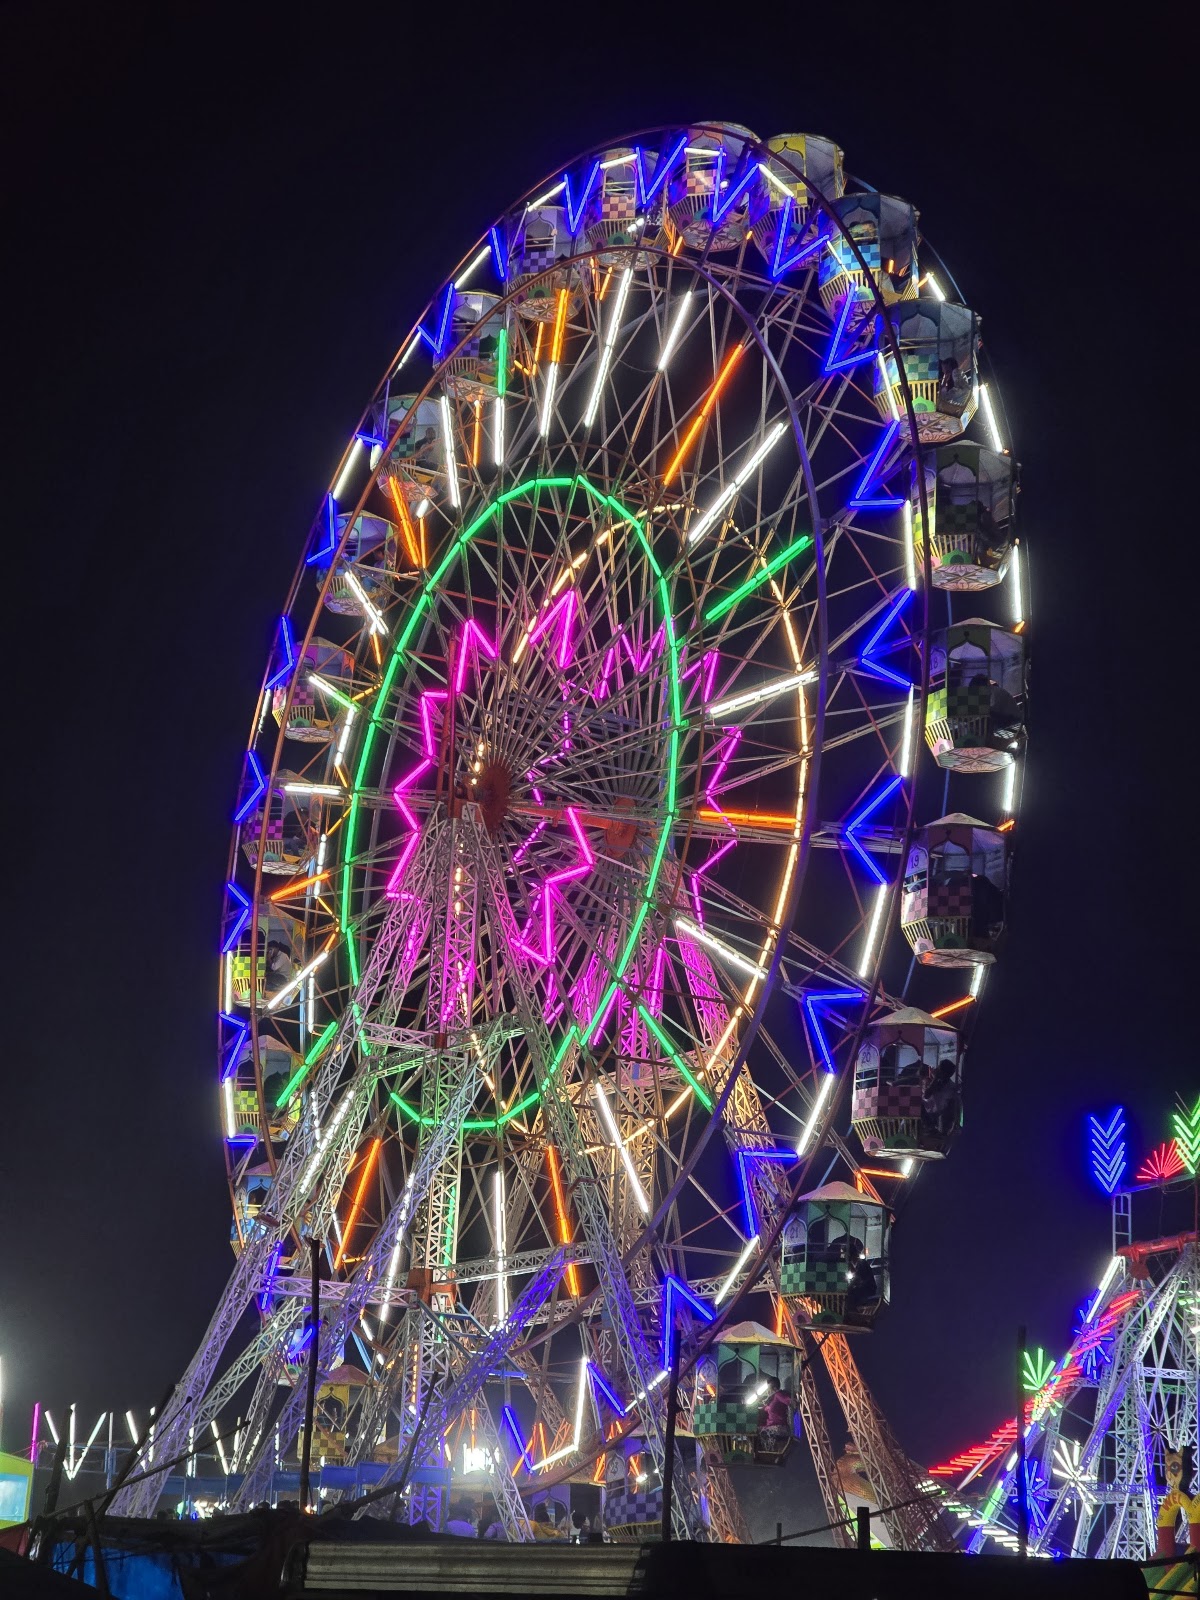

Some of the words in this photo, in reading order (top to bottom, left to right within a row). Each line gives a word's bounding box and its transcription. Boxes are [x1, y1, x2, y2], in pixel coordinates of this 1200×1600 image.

[911, 855, 920, 868] 19
[862, 1051, 871, 1063] 20
[790, 1227, 799, 1239] 21
